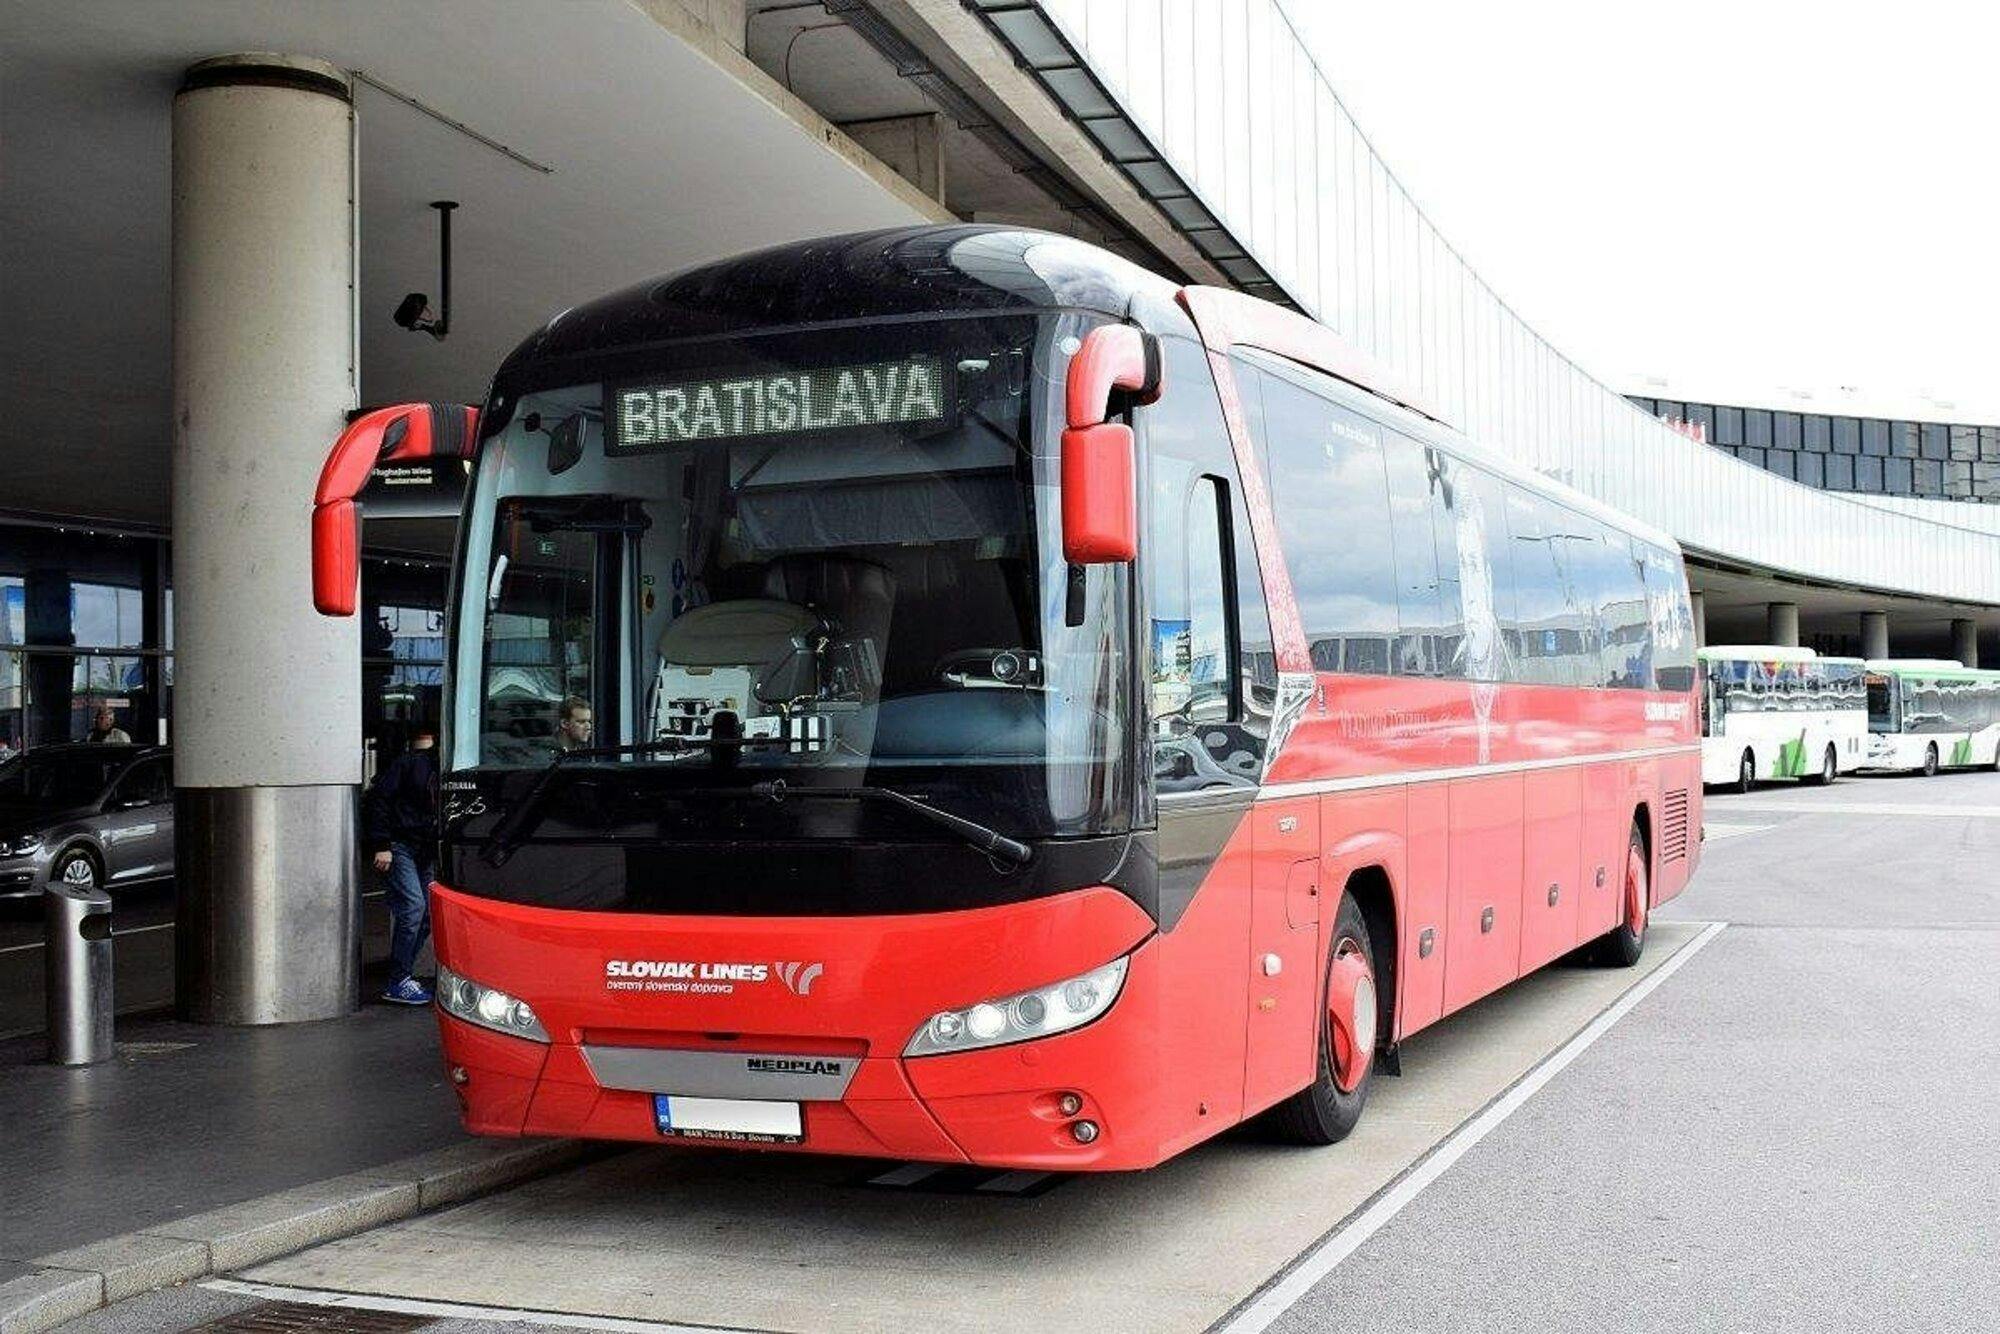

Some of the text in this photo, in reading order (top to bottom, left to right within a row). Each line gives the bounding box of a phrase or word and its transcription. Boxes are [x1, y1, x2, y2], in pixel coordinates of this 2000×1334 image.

[618, 363, 940, 446] BRATISLAVA
[606, 960, 768, 981] SLOVAK LINES
[606, 980, 733, 994] overený slovenský dopravca
[747, 1058, 841, 1075] NEOPLAN
